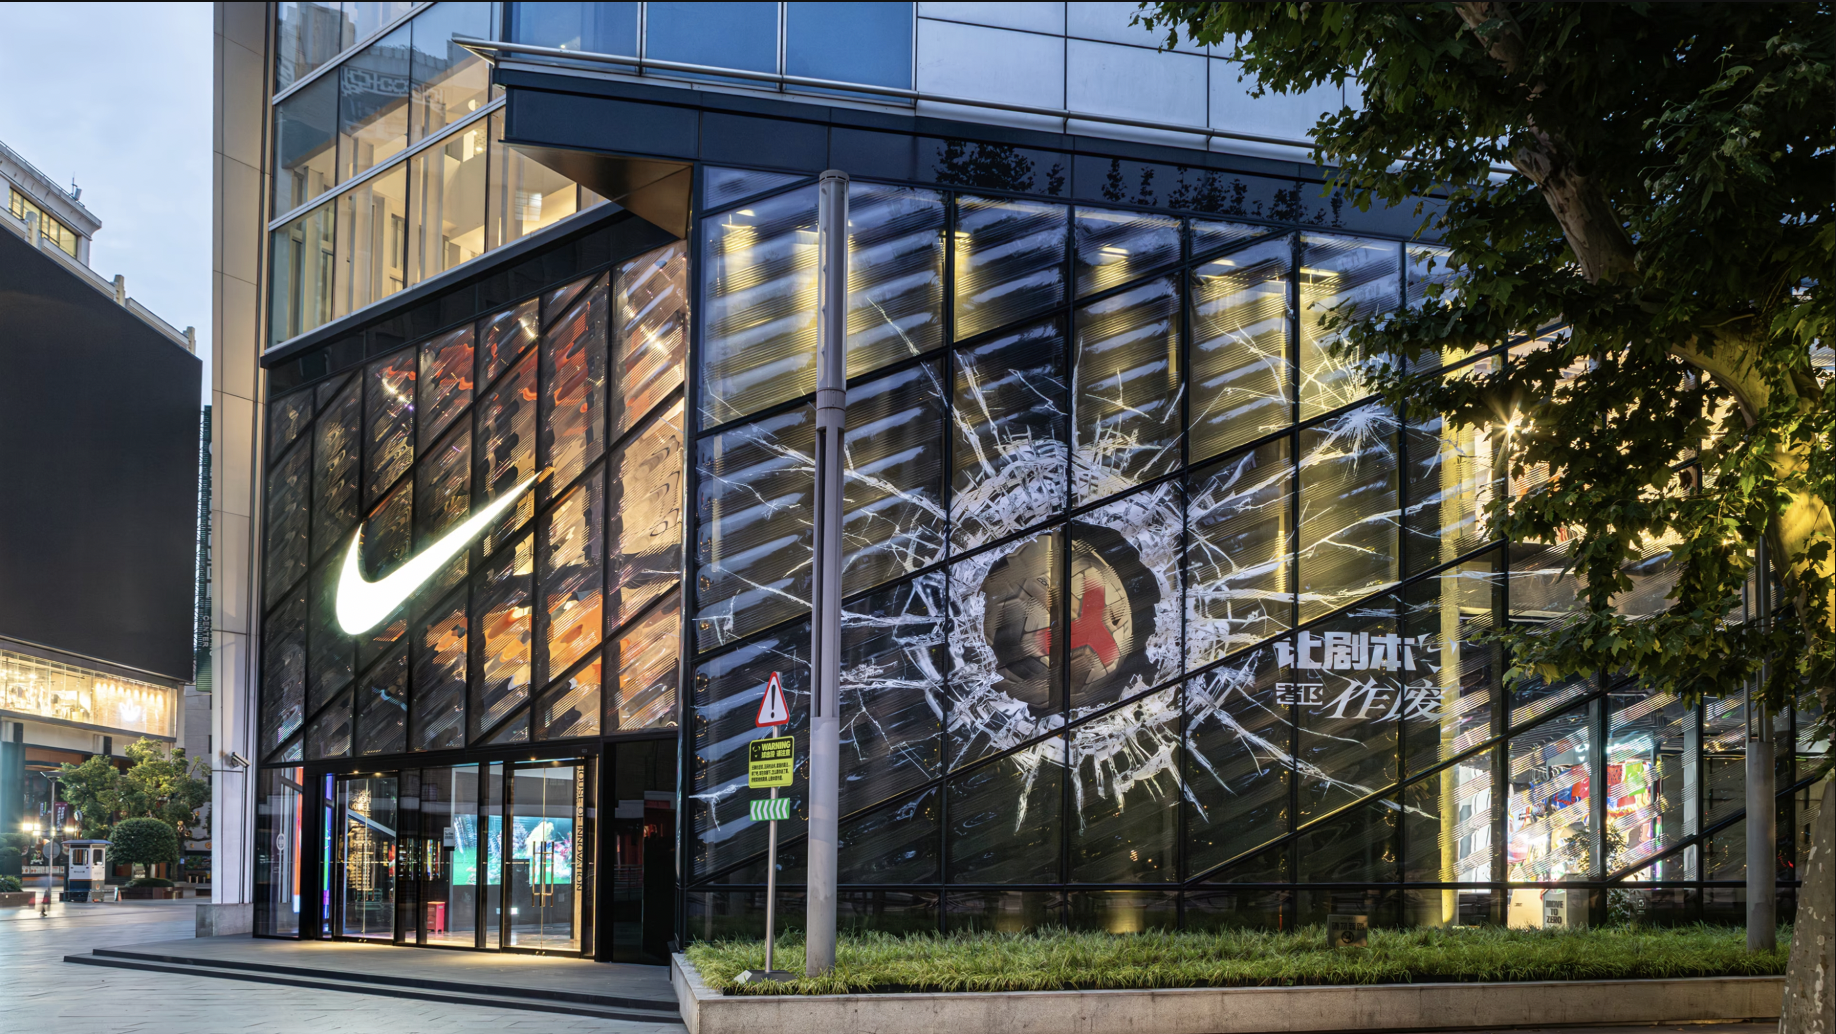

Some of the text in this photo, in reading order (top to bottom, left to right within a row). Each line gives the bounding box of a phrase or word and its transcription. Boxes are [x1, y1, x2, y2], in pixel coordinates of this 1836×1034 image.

[1273, 631, 1416, 671] 让剧本
[1276, 676, 1448, 724] 都作废
[761, 741, 791, 751] WARNING
[577, 806, 583, 821] OF
[1545, 900, 1564, 908] MOVE
[1550, 908, 1559, 916] TO
[1546, 916, 1563, 924] ZERO
